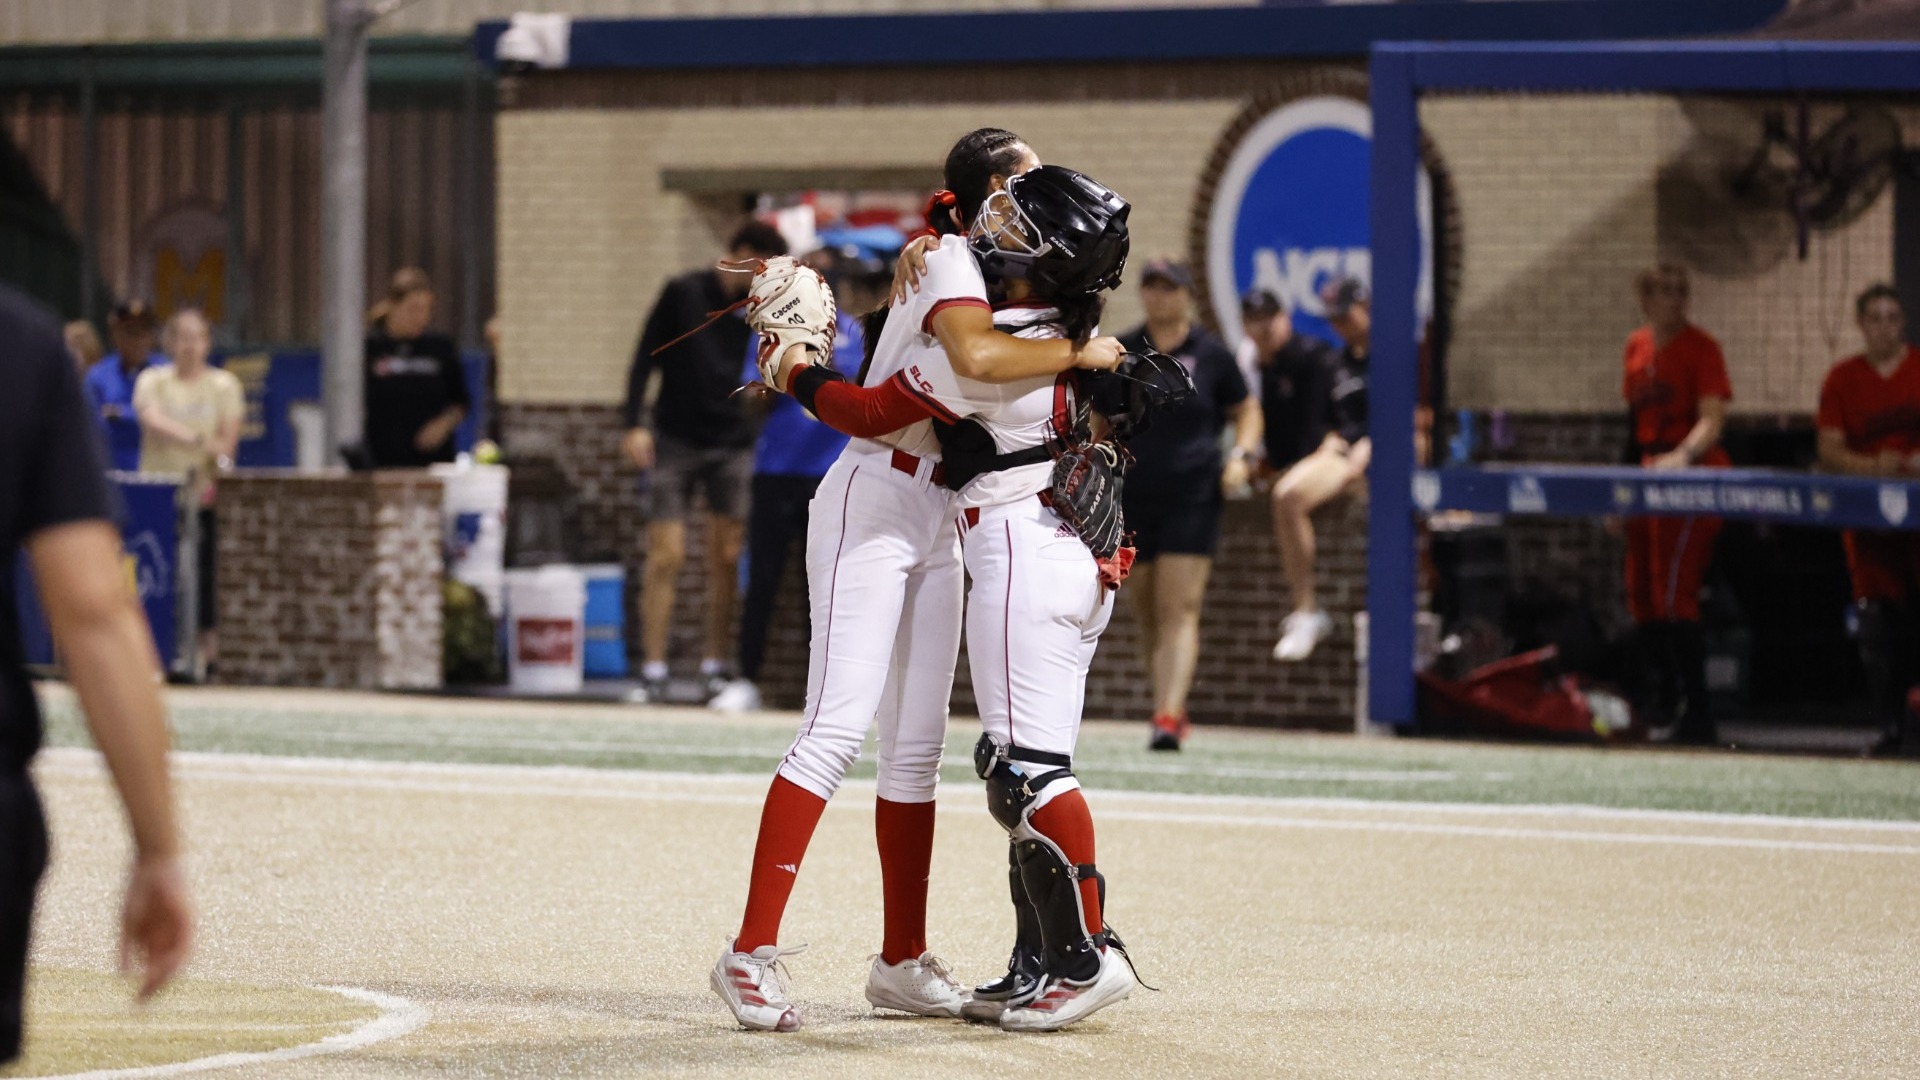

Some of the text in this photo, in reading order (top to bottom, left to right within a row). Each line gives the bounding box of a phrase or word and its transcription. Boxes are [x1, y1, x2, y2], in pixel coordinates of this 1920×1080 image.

[1049, 236, 1076, 258] EASTON
[771, 296, 801, 319] Caceres
[909, 364, 934, 394] SLC
[1089, 475, 1106, 515] EASTON
